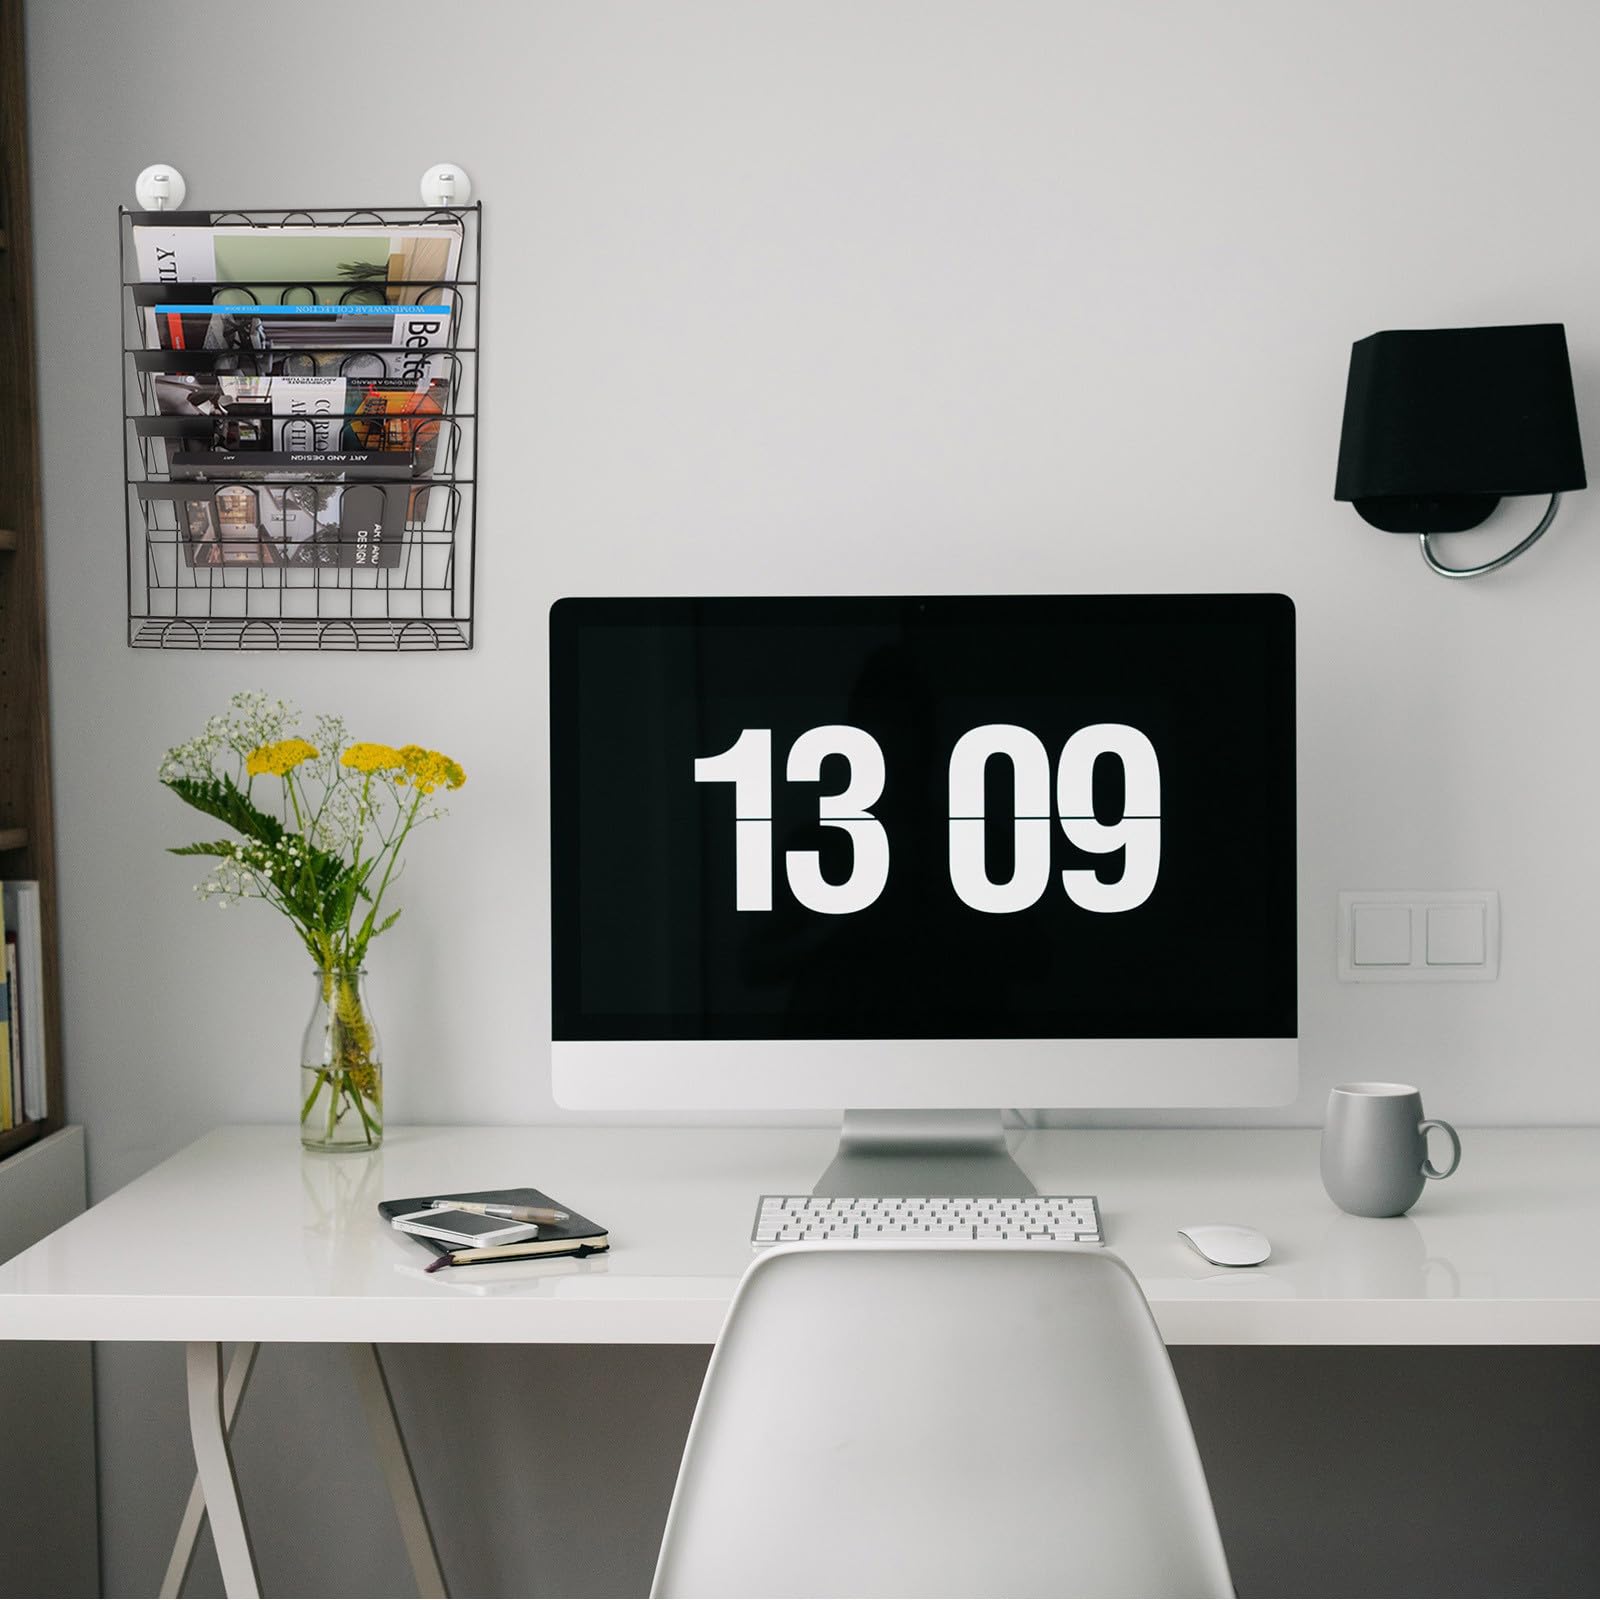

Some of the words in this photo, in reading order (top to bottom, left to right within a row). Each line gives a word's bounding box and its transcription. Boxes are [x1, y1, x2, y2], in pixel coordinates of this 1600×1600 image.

[356, 530, 368, 564] DESIGN
[694, 724, 890, 914] 13
[948, 723, 1161, 913] 09
